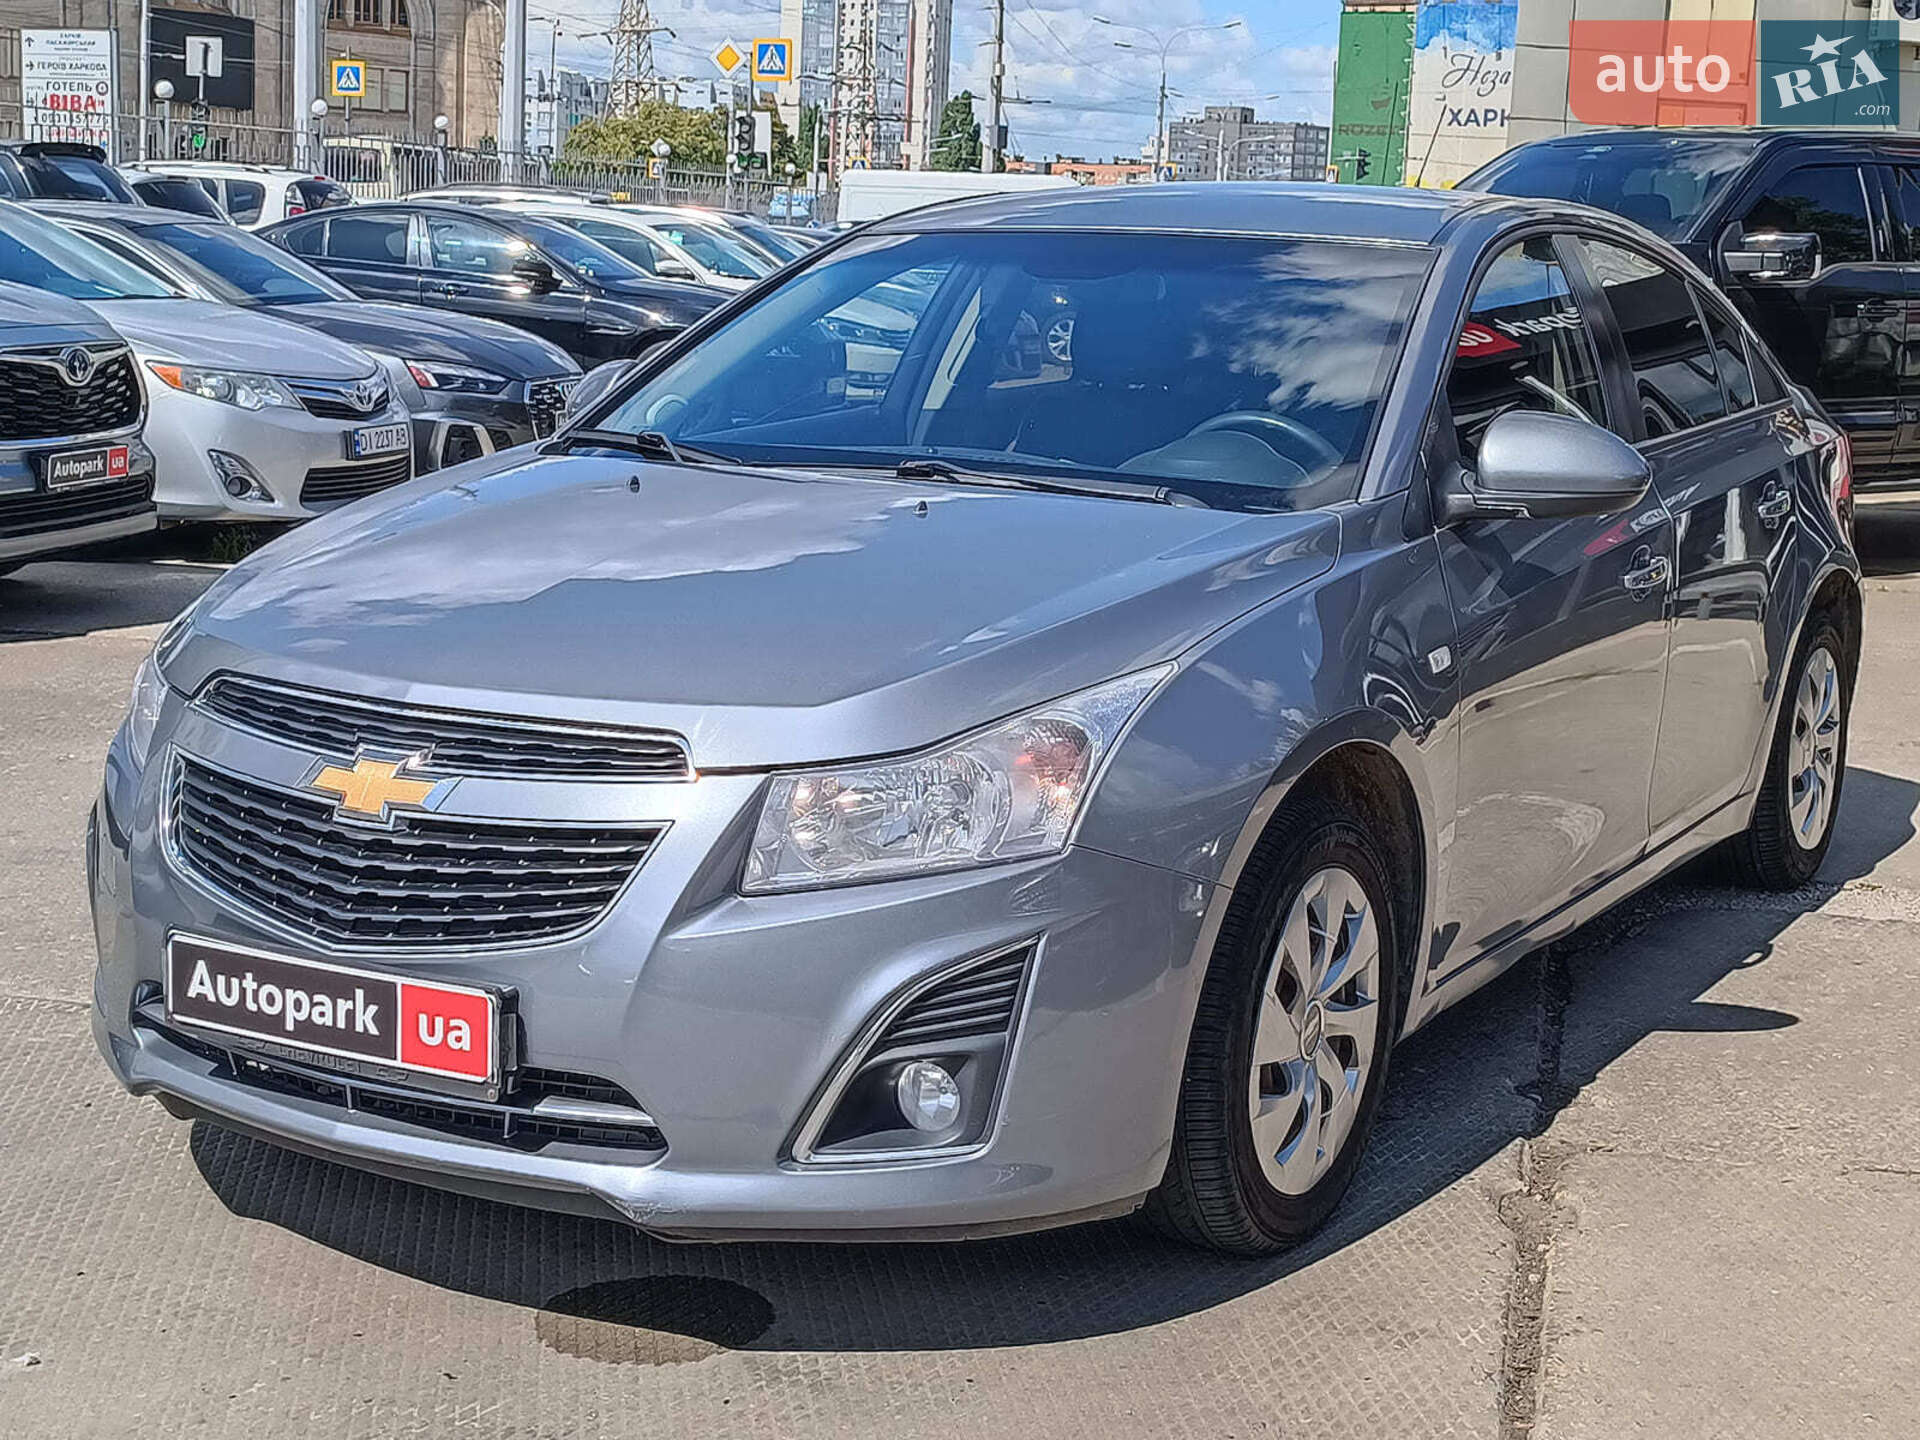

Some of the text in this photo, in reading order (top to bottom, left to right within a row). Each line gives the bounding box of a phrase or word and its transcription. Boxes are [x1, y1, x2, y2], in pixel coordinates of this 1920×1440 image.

[46, 81, 92, 92] ГОТЕЛЬ
[53, 454, 125, 479] Autopark ua
[187, 959, 471, 1051] Autopark ua
